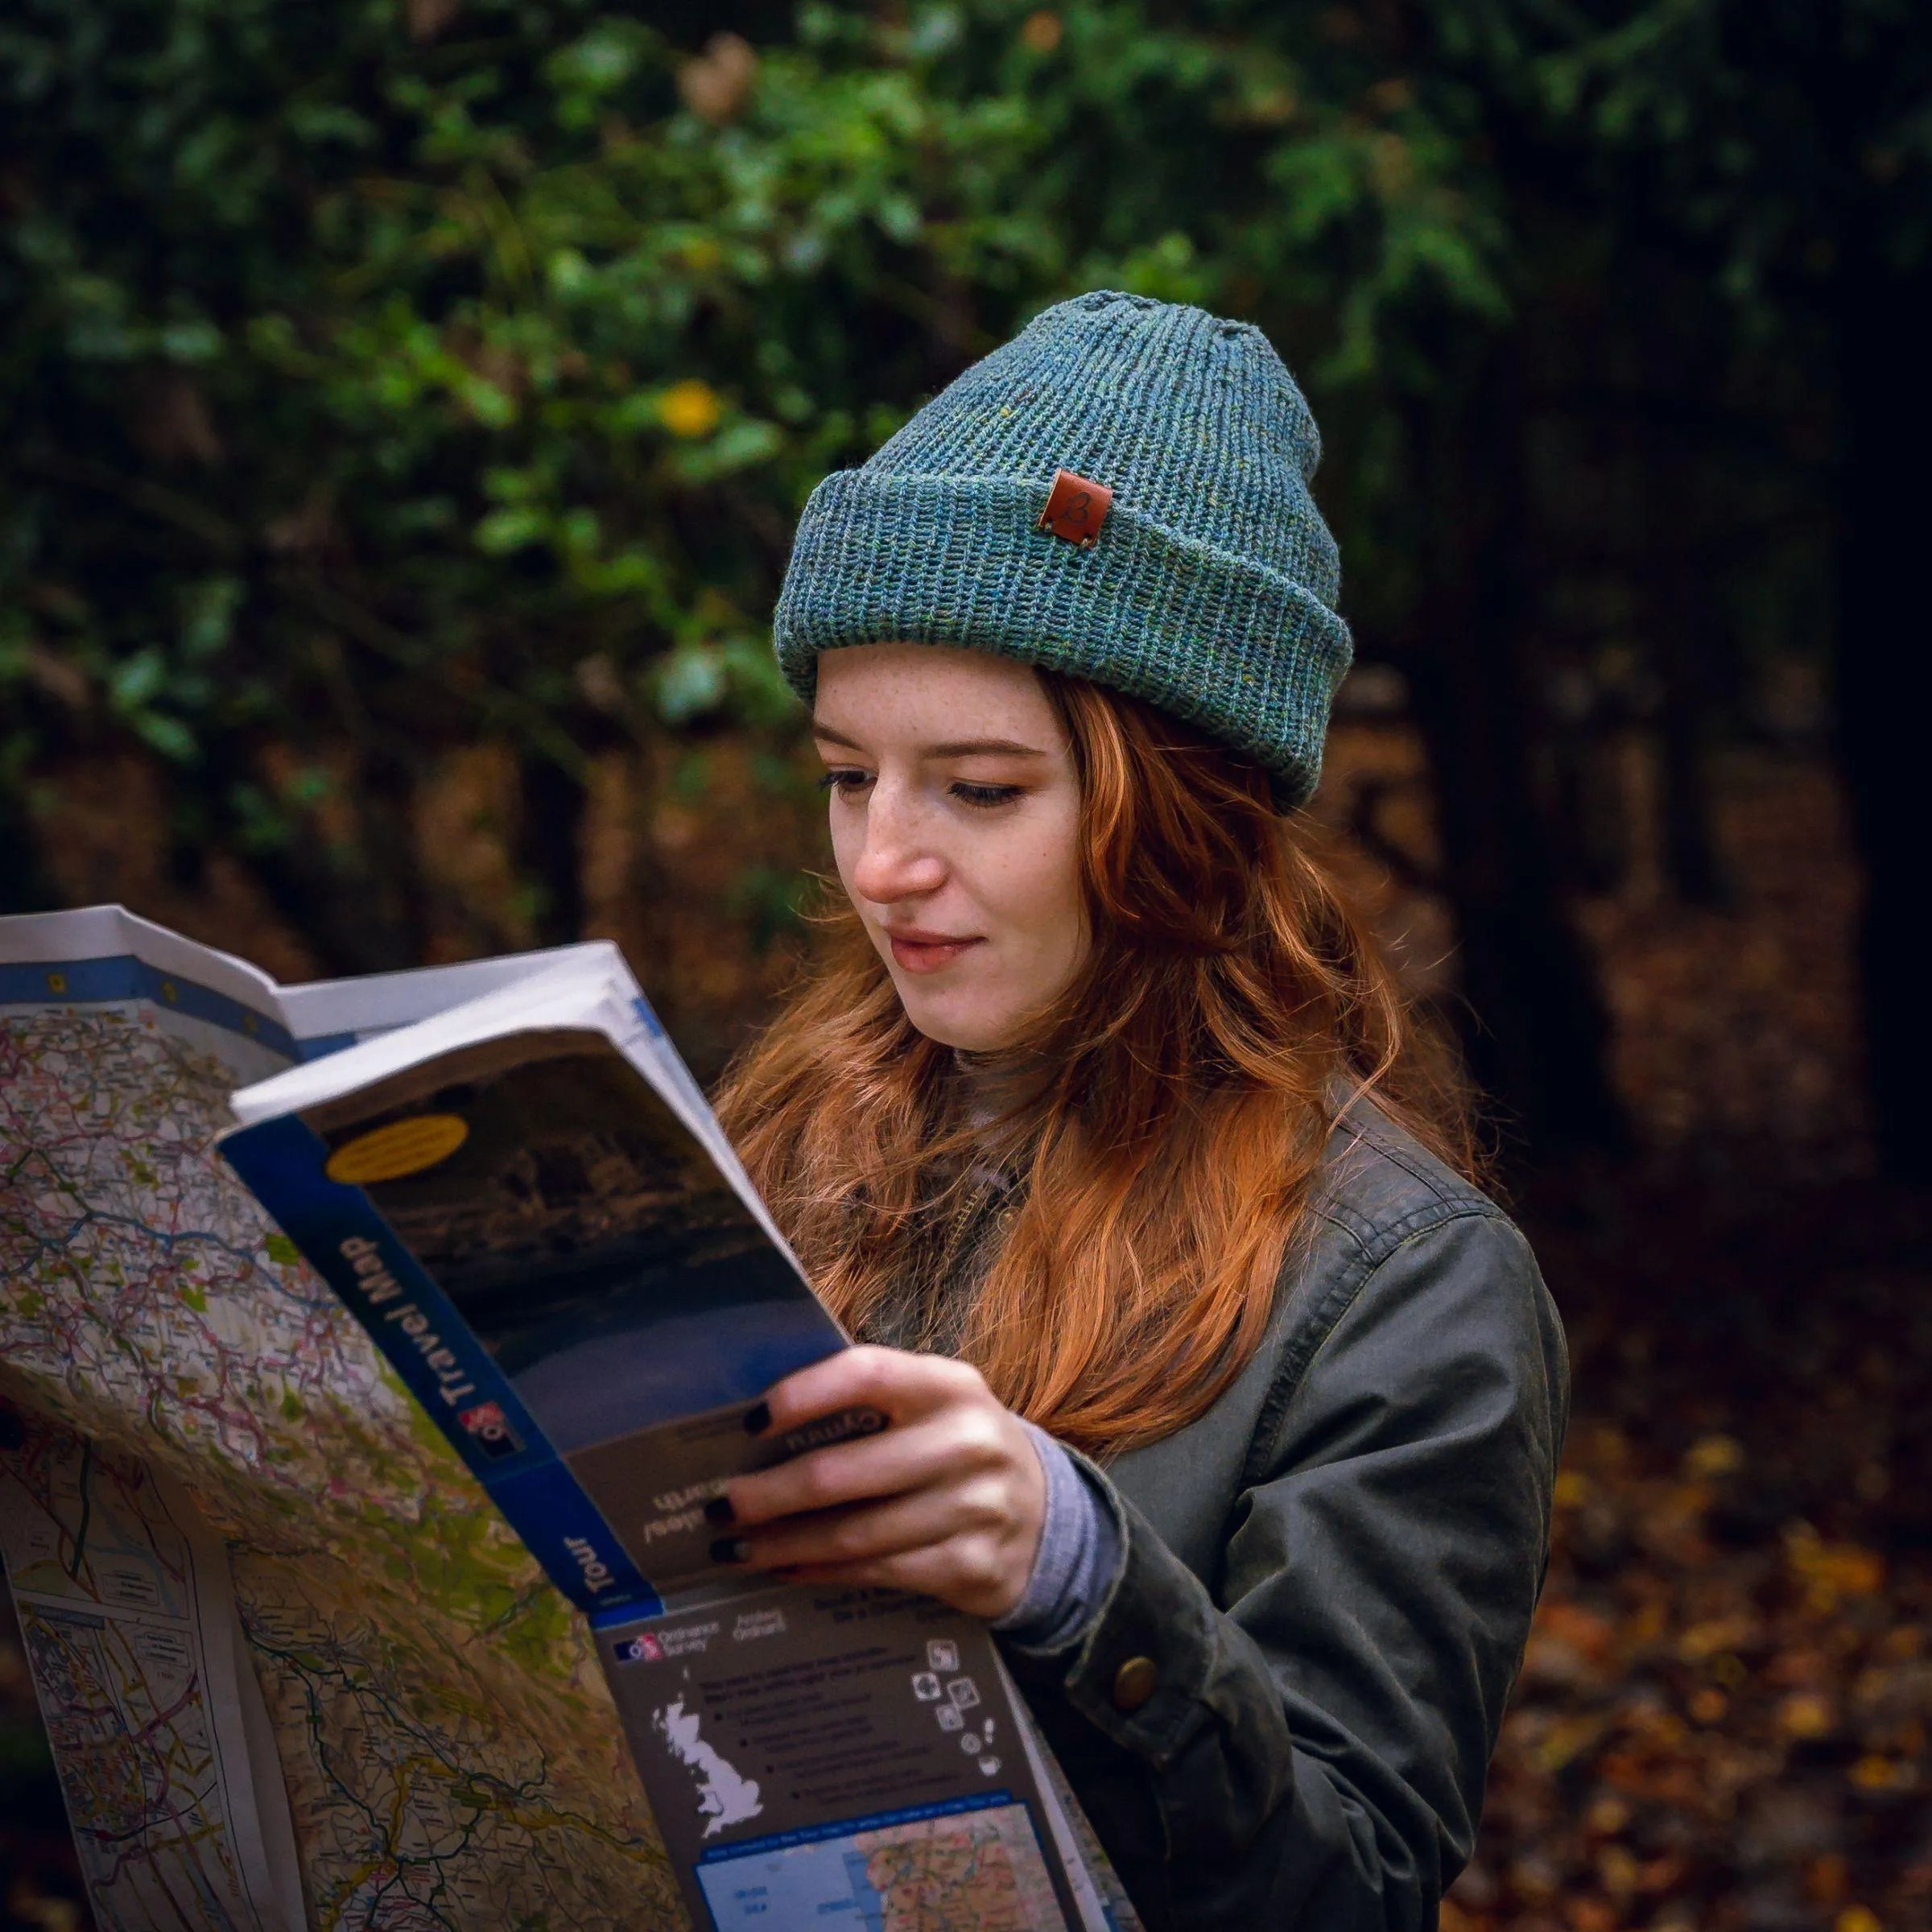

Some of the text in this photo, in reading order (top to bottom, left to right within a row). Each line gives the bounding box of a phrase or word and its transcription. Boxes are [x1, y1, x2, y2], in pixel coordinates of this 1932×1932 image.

[339, 1236, 402, 1305] Map
[383, 1302, 477, 1407] Travel
[564, 1536, 615, 1594] Tour
